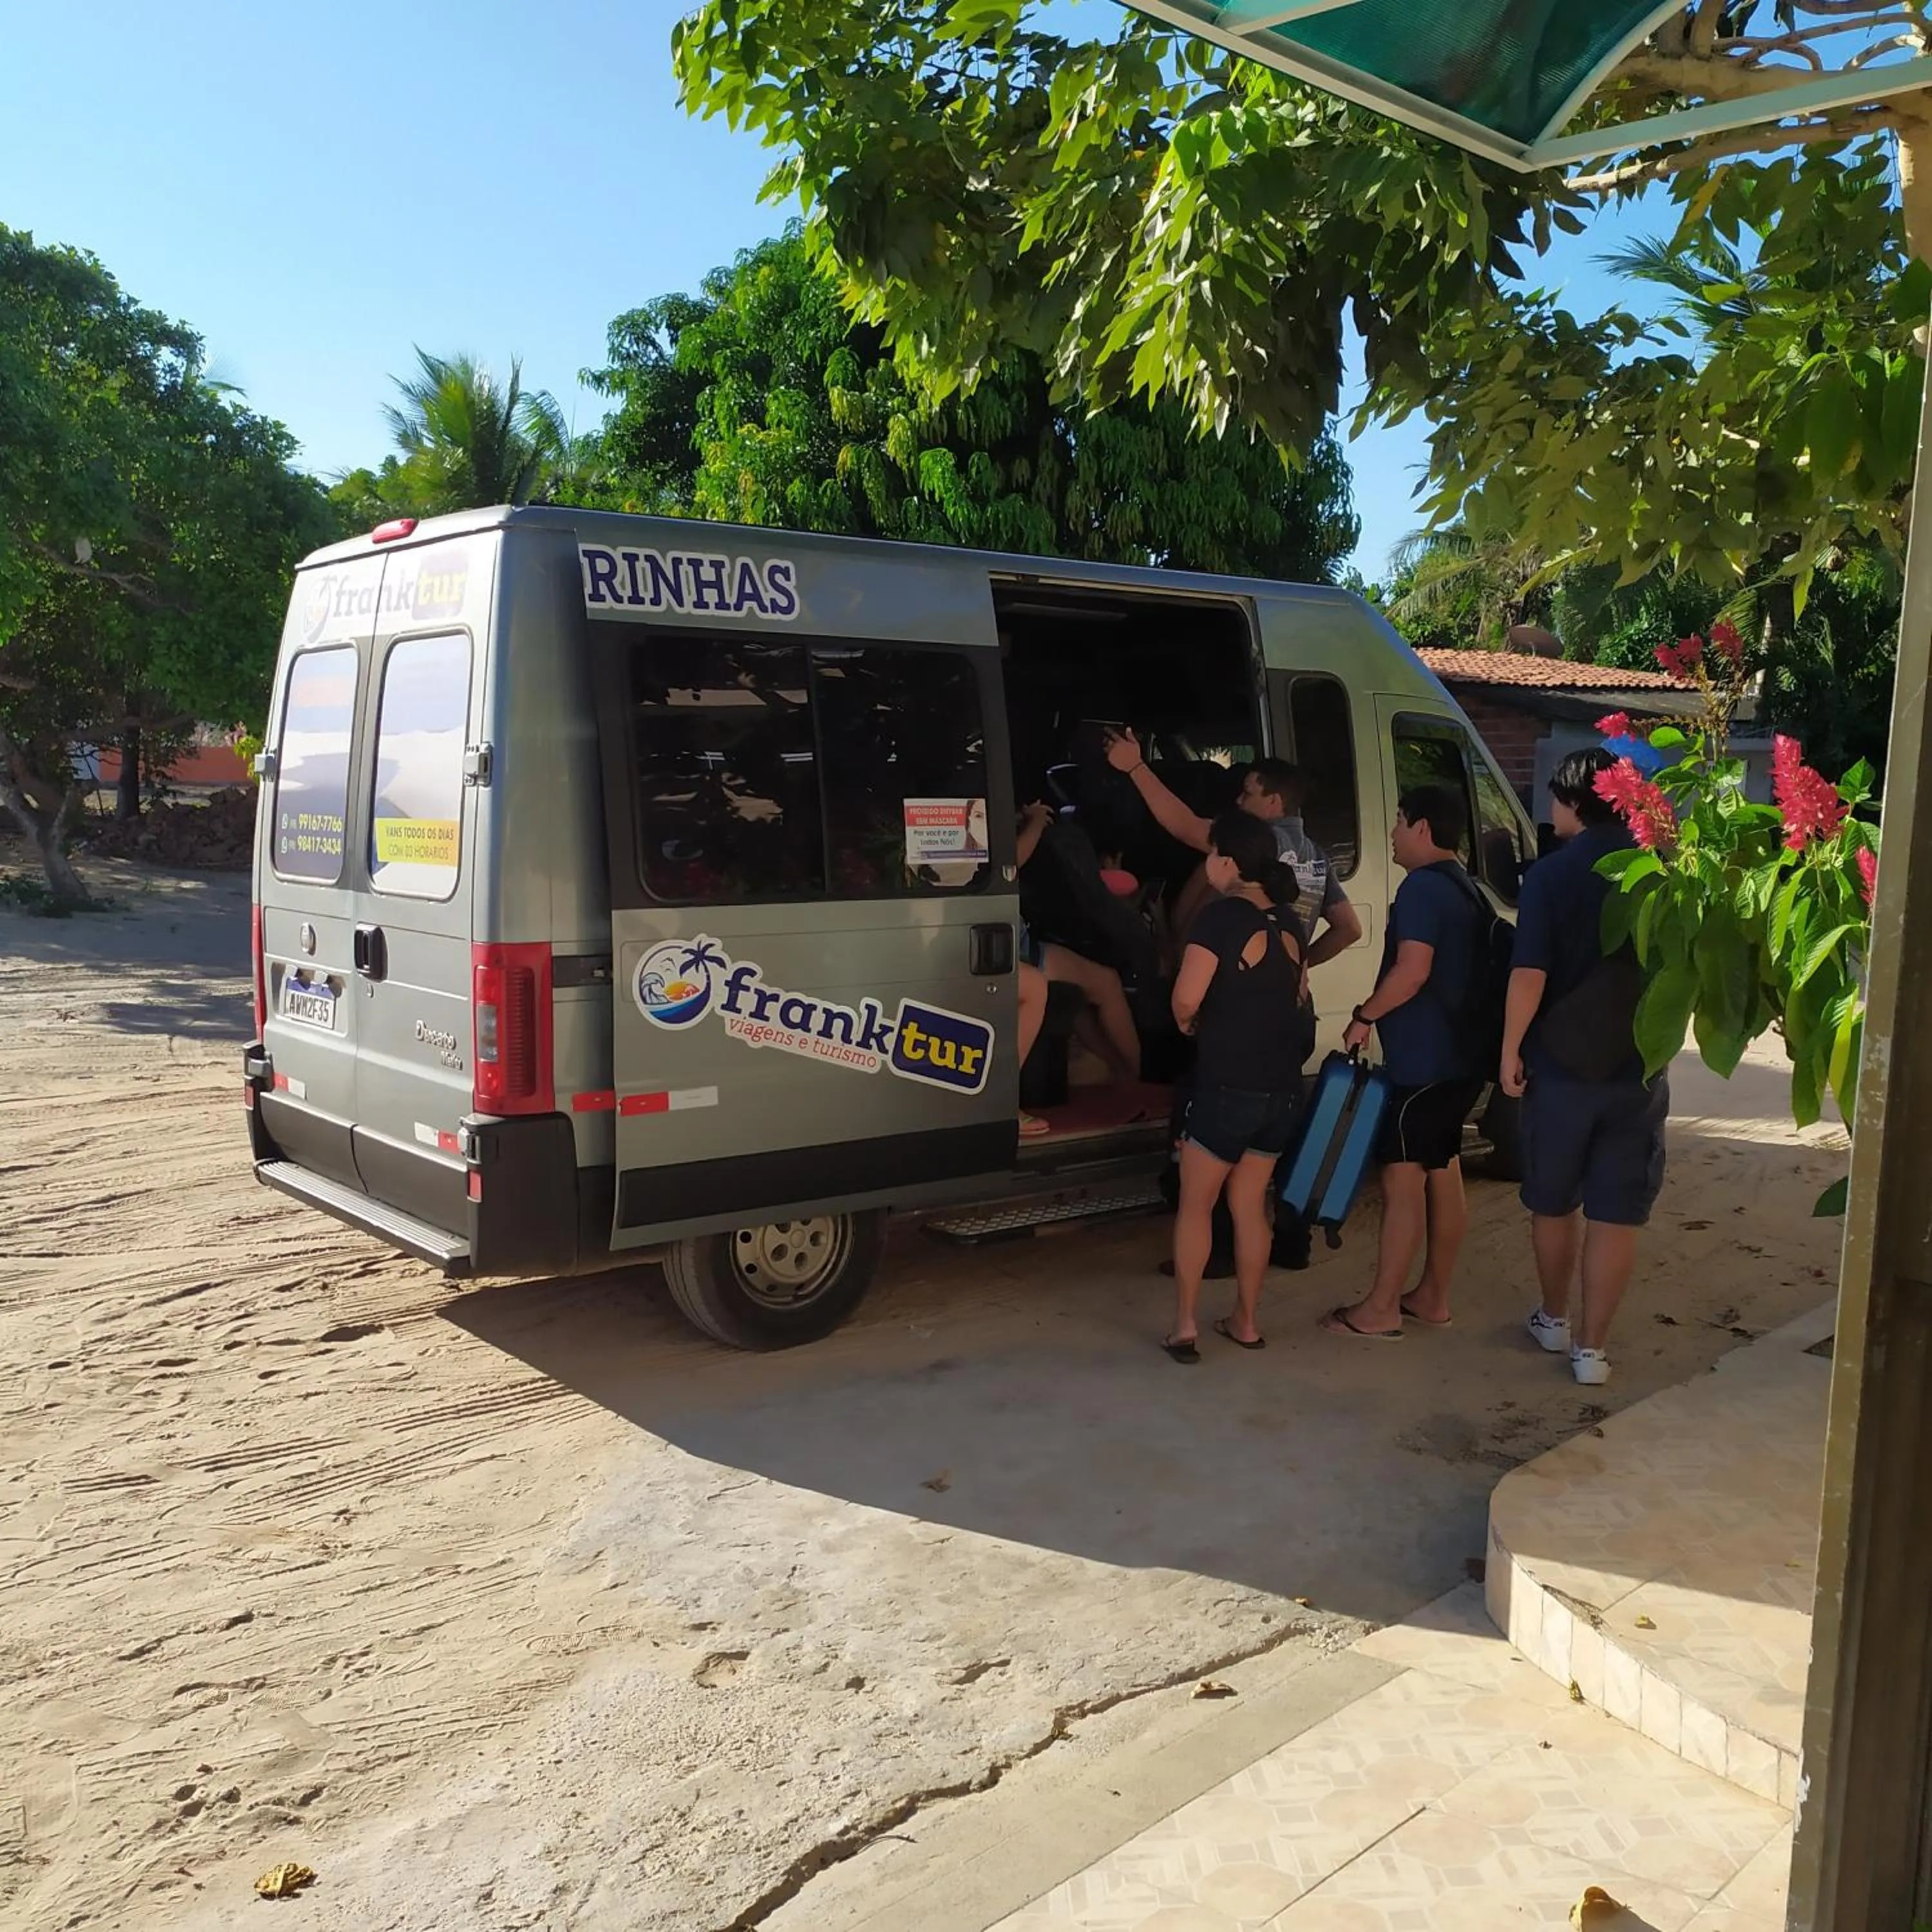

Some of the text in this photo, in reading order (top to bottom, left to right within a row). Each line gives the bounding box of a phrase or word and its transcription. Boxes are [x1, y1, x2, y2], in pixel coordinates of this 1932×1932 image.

[582, 548, 796, 616] RINHAS
[386, 826, 454, 840] VANS TODOS OS DIAS
[729, 1016, 877, 1069] viagens e turismo
